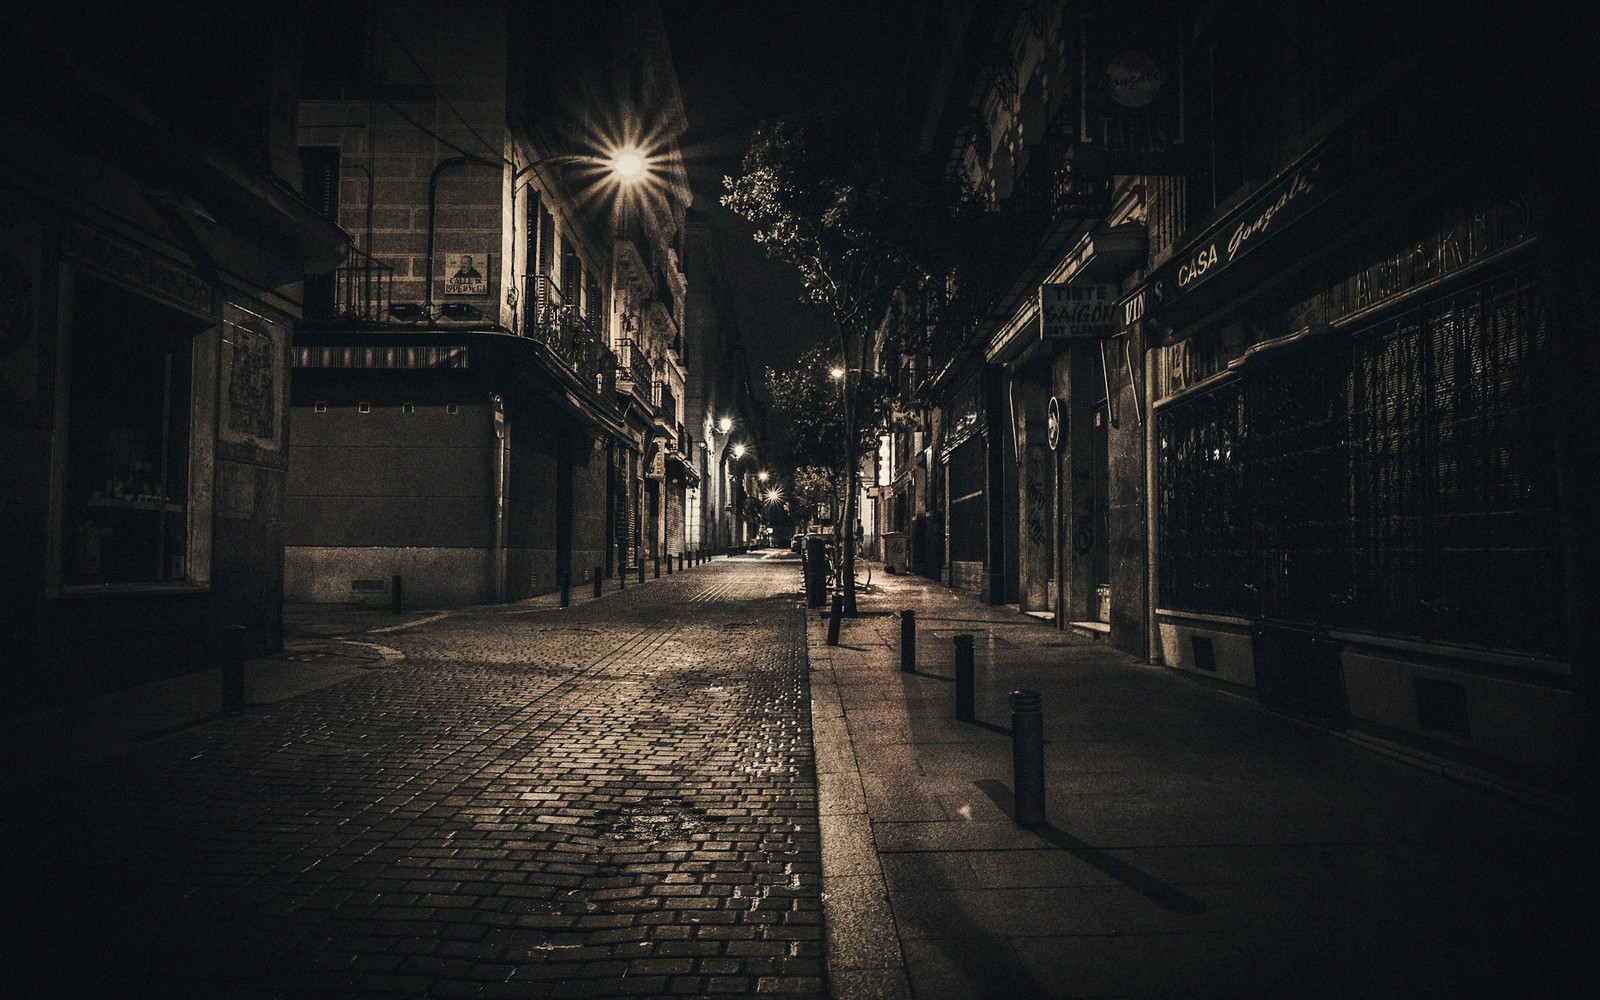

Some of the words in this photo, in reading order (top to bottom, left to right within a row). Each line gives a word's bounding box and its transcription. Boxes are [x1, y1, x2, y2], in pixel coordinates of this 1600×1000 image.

[1053, 286, 1107, 301] TINTE
[1125, 281, 1163, 325] VINS
[1178, 244, 1218, 288] CASA
[1045, 302, 1117, 323] SAIGON
